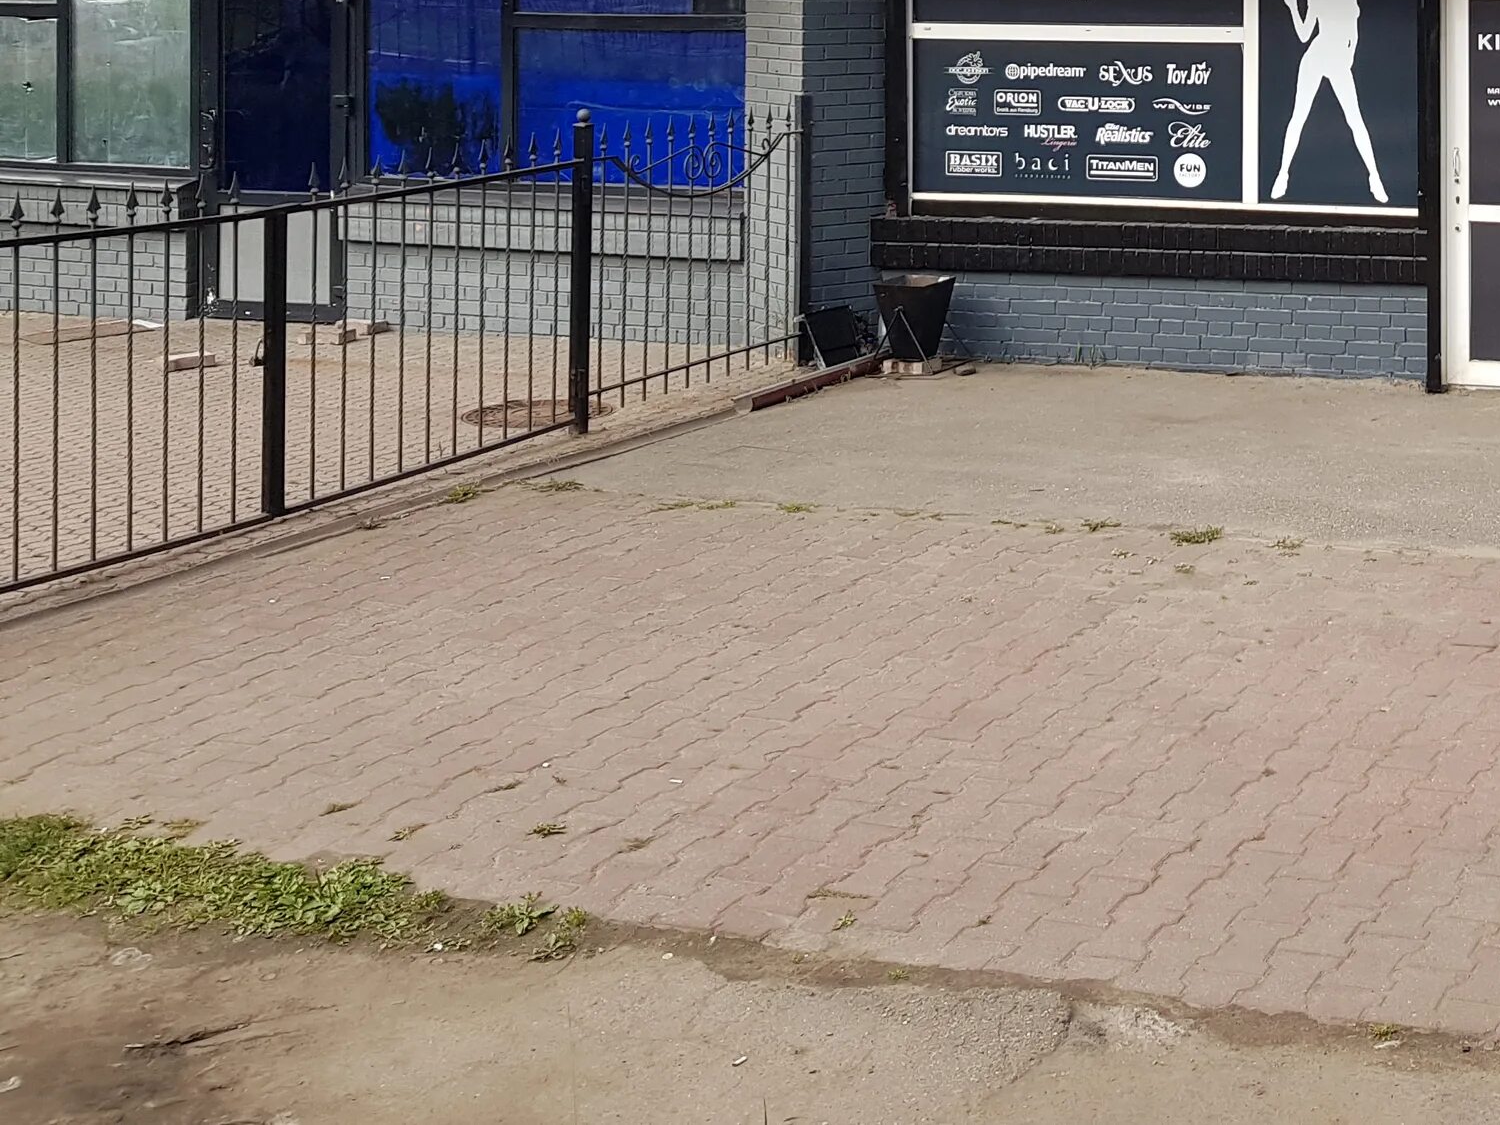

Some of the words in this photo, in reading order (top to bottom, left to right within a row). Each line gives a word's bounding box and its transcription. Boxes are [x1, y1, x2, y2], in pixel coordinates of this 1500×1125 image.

[1019, 62, 1084, 80] pipedream
[996, 92, 1038, 106] ORION
[946, 124, 1009, 137] dreamtoys
[1095, 126, 1154, 146] Realistics
[1168, 121, 1211, 148] Elite
[949, 153, 998, 166] BASIX
[949, 165, 973, 173] rubber
[1179, 163, 1201, 173] FUN
